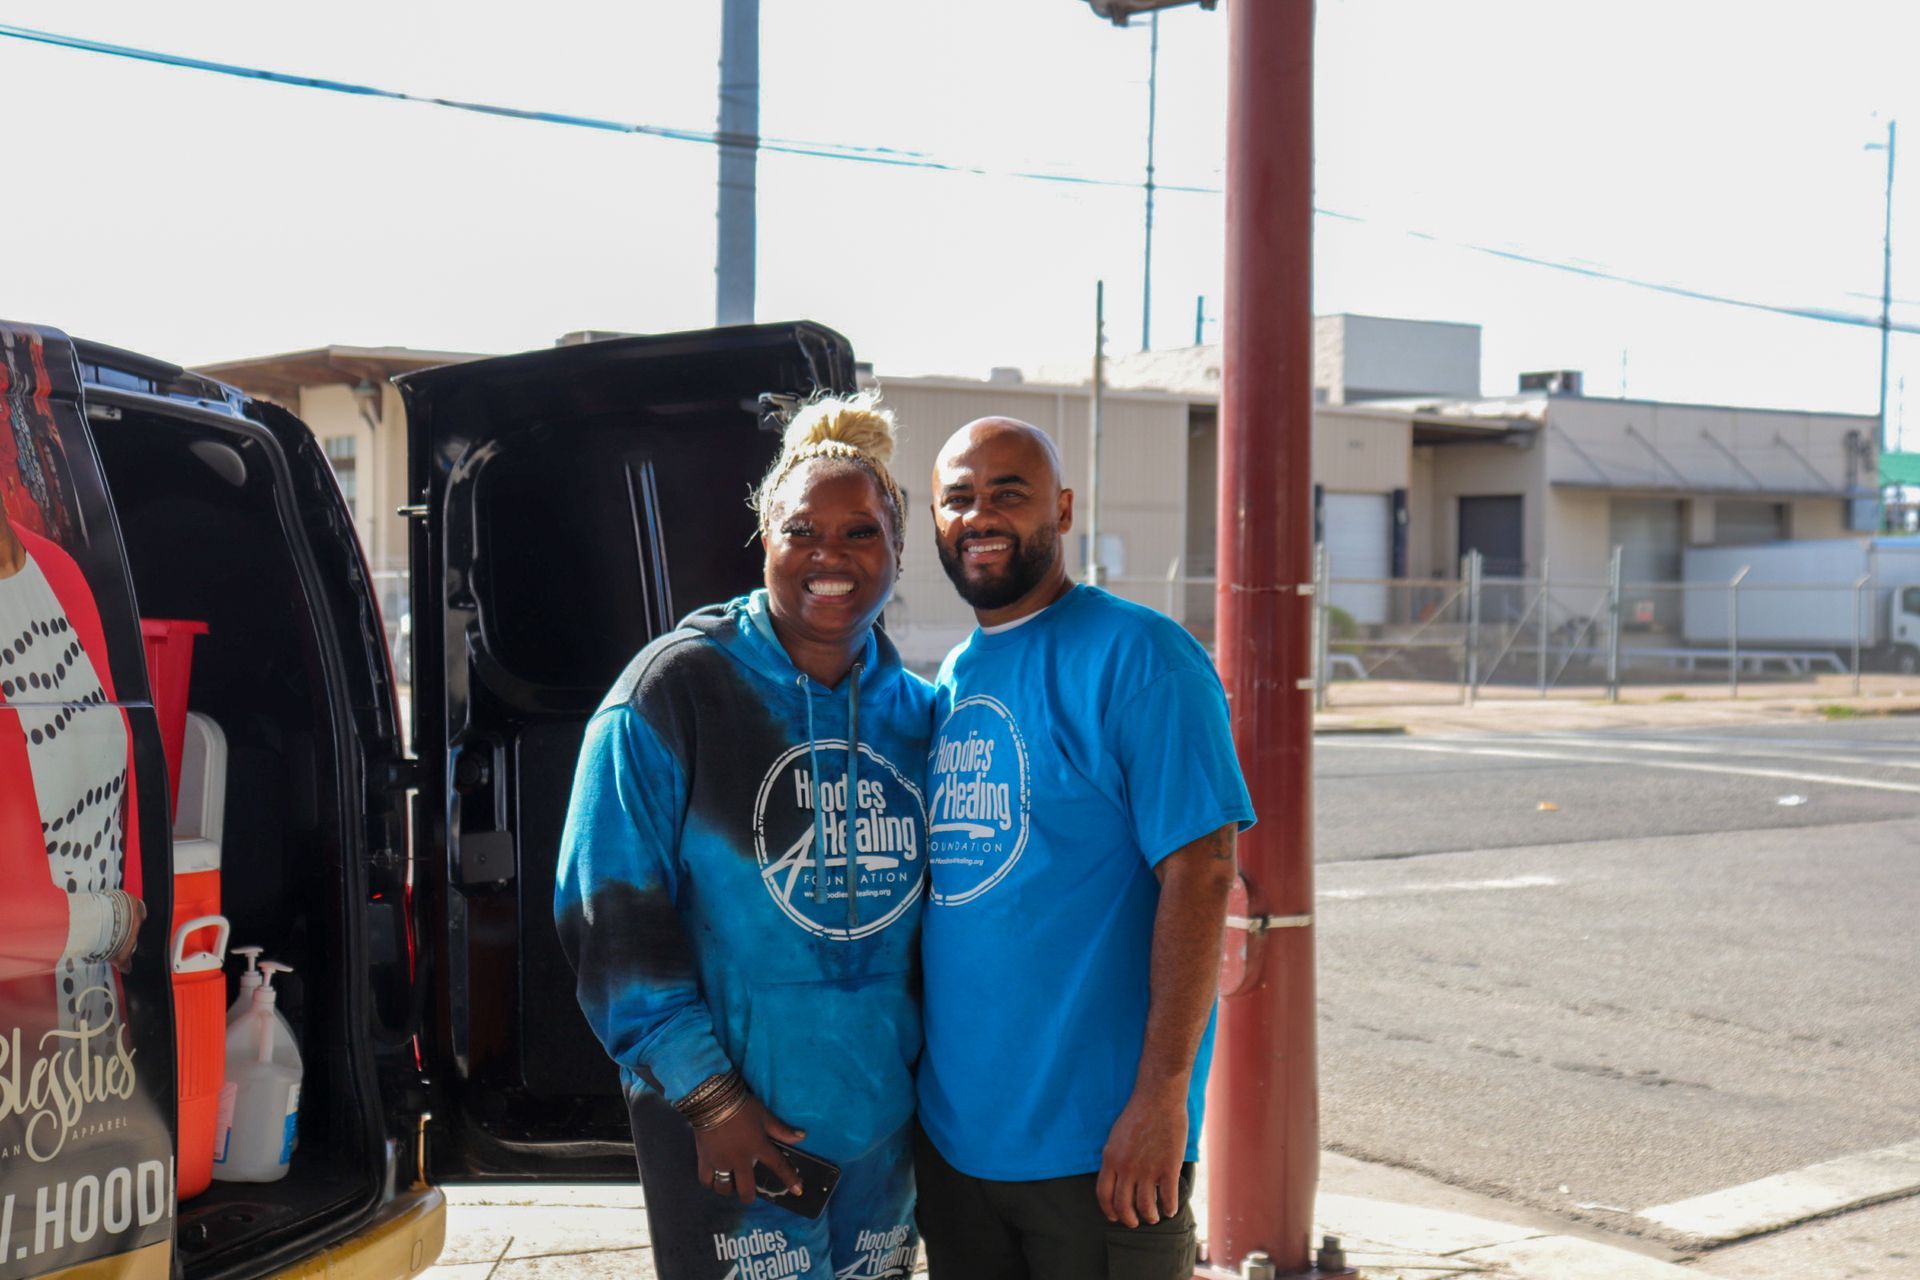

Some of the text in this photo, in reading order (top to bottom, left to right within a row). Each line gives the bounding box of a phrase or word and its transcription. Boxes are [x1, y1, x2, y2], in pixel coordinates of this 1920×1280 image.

[933, 730, 994, 775] Hoodies
[795, 769, 886, 812] Hodes
[943, 772, 1012, 831] Healing
[821, 808, 917, 861] Healing
[930, 841, 1002, 853] OUNDATION
[803, 872, 908, 886] FNATION
[72, 1116, 128, 1141] APPAREL
[713, 1228, 788, 1261] Hoodies
[739, 1246, 811, 1280] Healing
